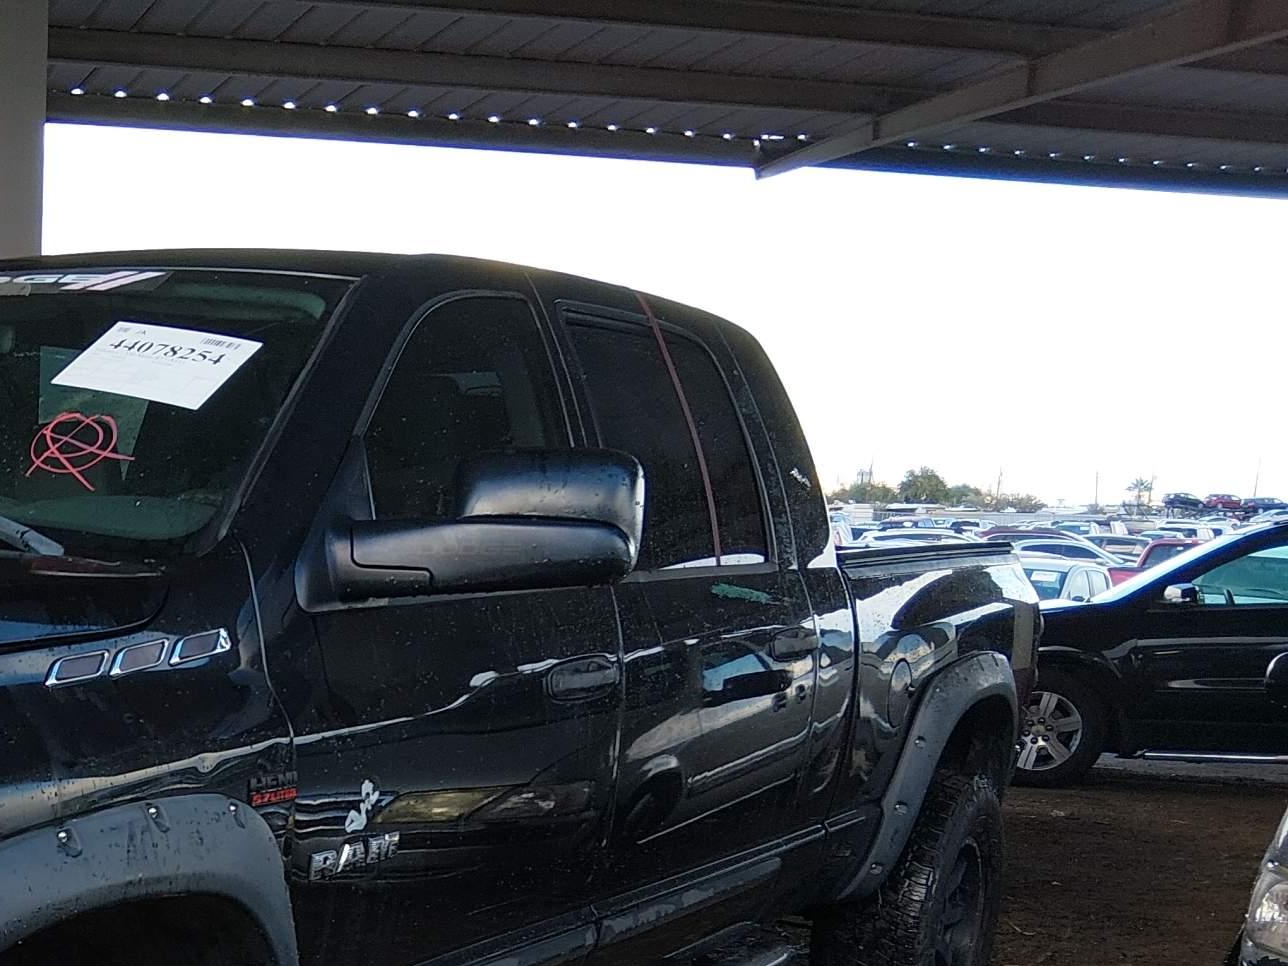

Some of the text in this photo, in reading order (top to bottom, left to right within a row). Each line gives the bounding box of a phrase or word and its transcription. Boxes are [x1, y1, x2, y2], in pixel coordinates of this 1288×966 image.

[109, 337, 227, 366] 44078254
[250, 771, 298, 791] HEMI
[309, 830, 400, 881] RAM
